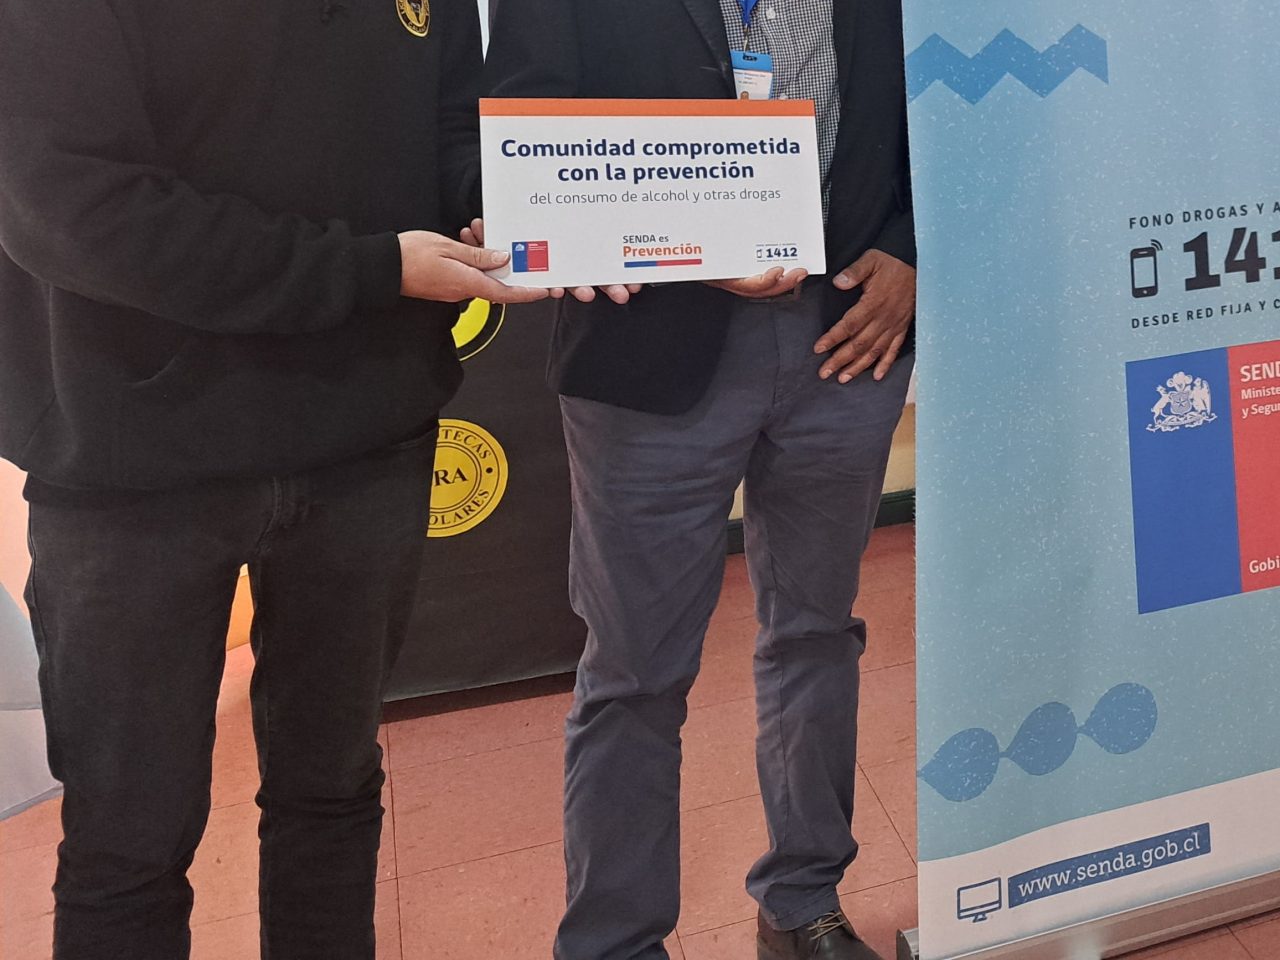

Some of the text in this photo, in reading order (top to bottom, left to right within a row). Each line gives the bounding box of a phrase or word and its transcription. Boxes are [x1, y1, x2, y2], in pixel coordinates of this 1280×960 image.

[501, 137, 800, 159] Comunidad comprometida
[558, 161, 754, 184] con la prevención
[529, 188, 782, 205] del consumo de alcohol y otras drogas
[1129, 213, 1174, 230] FONO
[1183, 204, 1248, 224] DROGAS
[1256, 202, 1264, 214] Y
[622, 234, 670, 244] SENDA es
[622, 242, 703, 258] Prevención
[766, 247, 798, 258] 1412
[1131, 312, 1180, 329] DESDE
[1186, 307, 1214, 321] RED
[1220, 302, 1253, 316] FIJA
[1258, 300, 1267, 312] Y
[1242, 406, 1248, 418] y
[1018, 832, 1201, 898] www.senda.gob.cl
